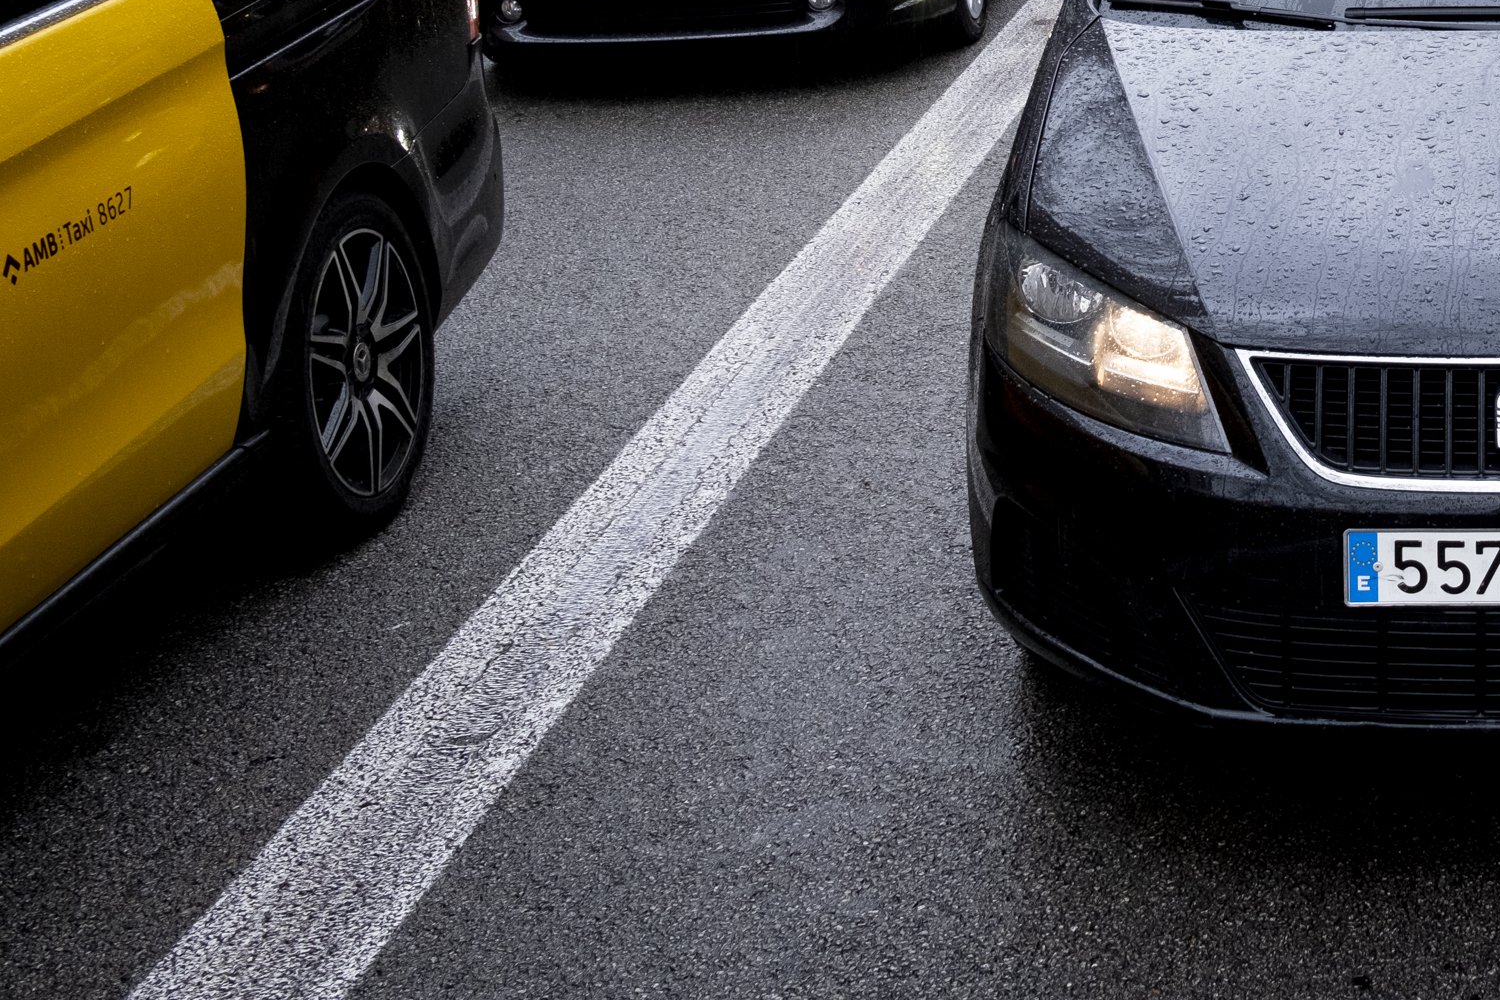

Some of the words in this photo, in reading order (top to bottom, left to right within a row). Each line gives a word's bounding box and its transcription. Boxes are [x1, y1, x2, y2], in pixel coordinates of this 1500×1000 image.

[23, 232, 59, 272] AMB
[62, 208, 94, 245] Taxi
[97, 185, 132, 226] 8627
[1356, 575, 1371, 591] E
